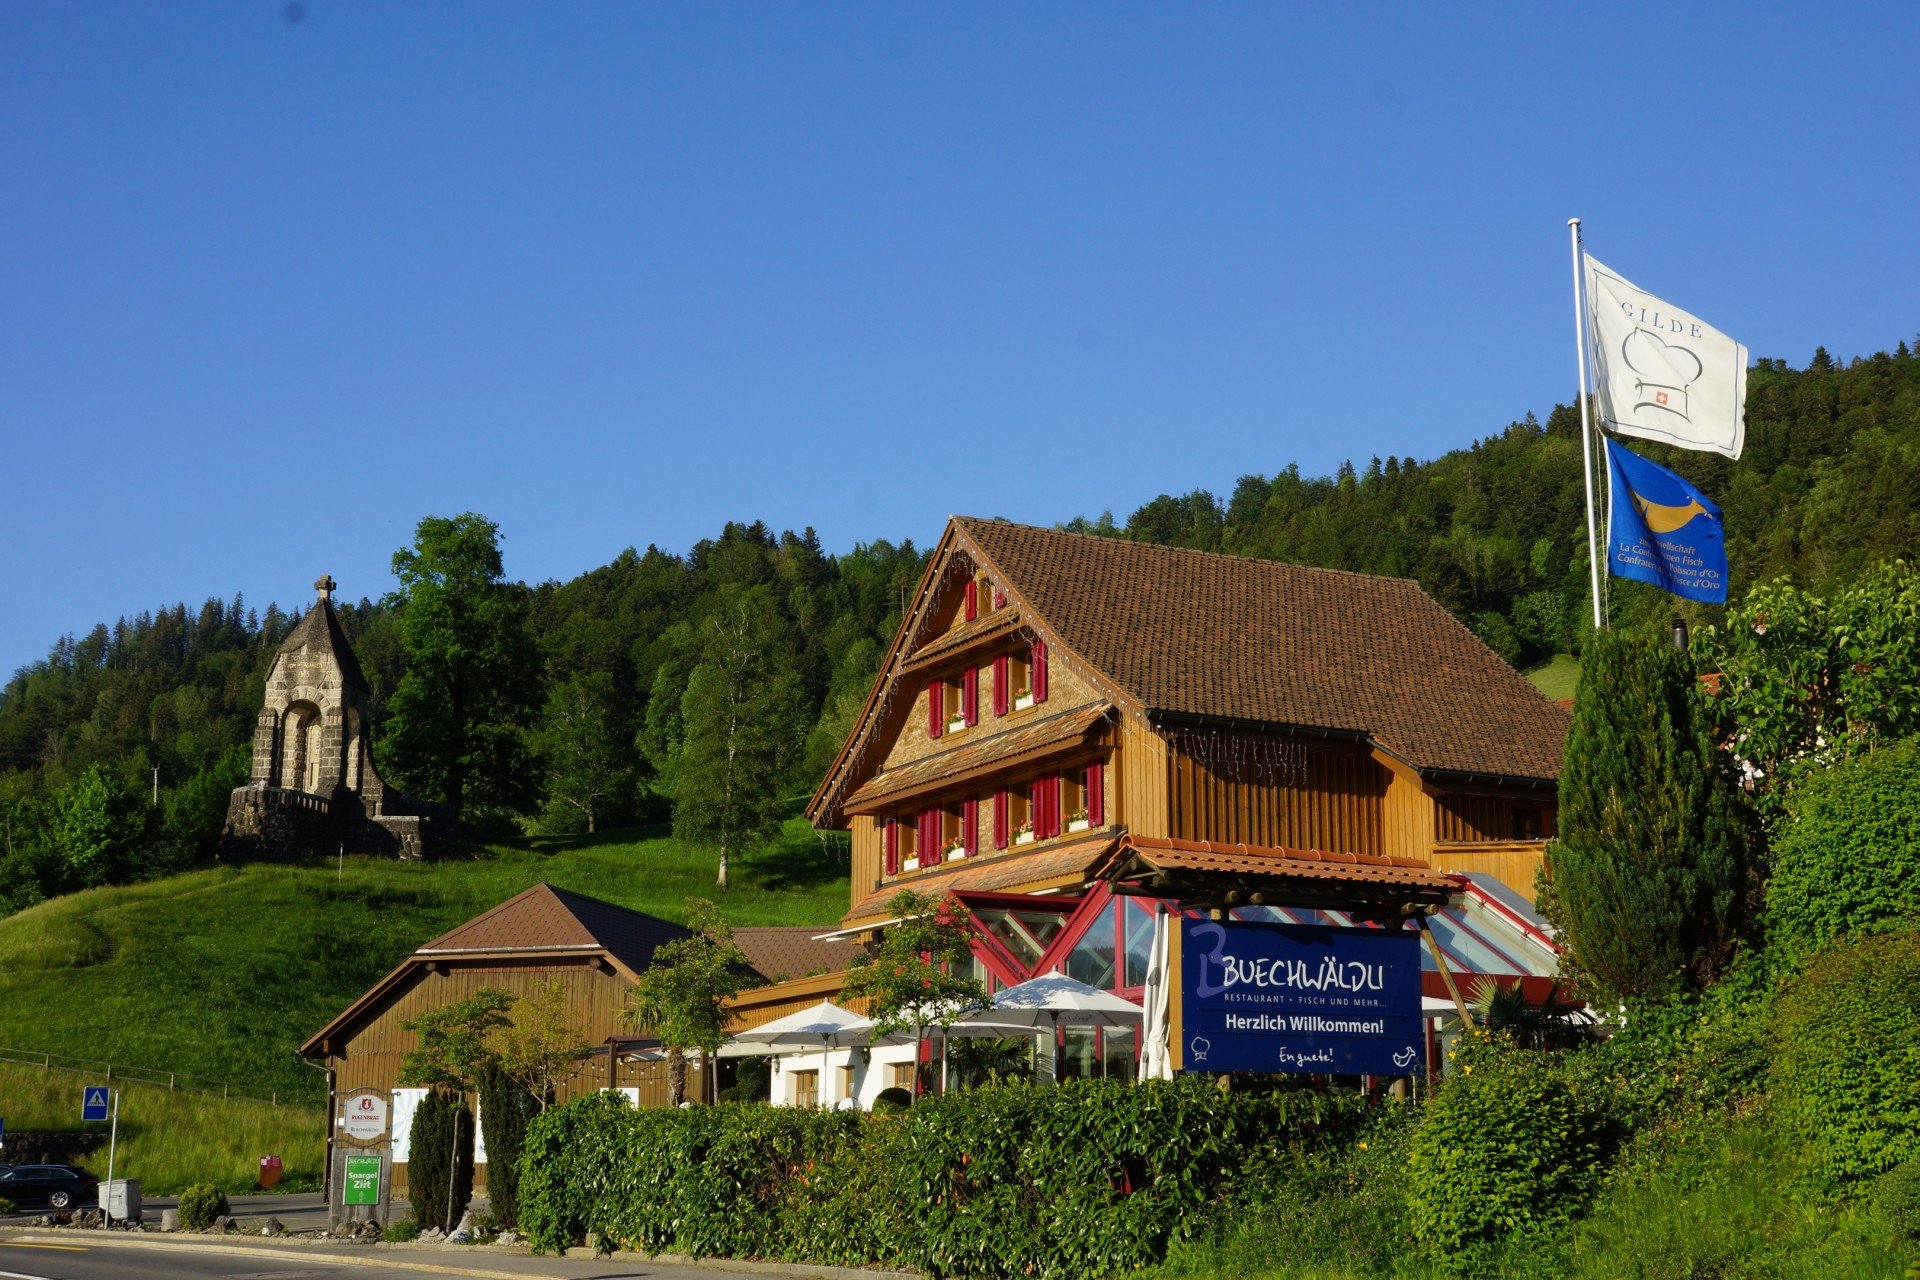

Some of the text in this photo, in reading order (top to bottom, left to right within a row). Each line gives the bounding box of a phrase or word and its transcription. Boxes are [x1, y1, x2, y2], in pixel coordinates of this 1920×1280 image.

[1621, 302, 1702, 338] GILDE
[1620, 543, 1630, 552] La
[1670, 563, 1697, 577] Poisson
[1699, 569, 1721, 579] d'Or
[1682, 555, 1704, 567] Fisch
[1693, 579, 1720, 589] d'Oro
[1224, 993, 1388, 1008] RESTAURANT FISCH UND MEHR...
[1226, 1013, 1384, 1034] Herzlich Willkommen!
[1279, 1046, 1334, 1067] En guete!
[348, 1172, 378, 1181] Spargel
